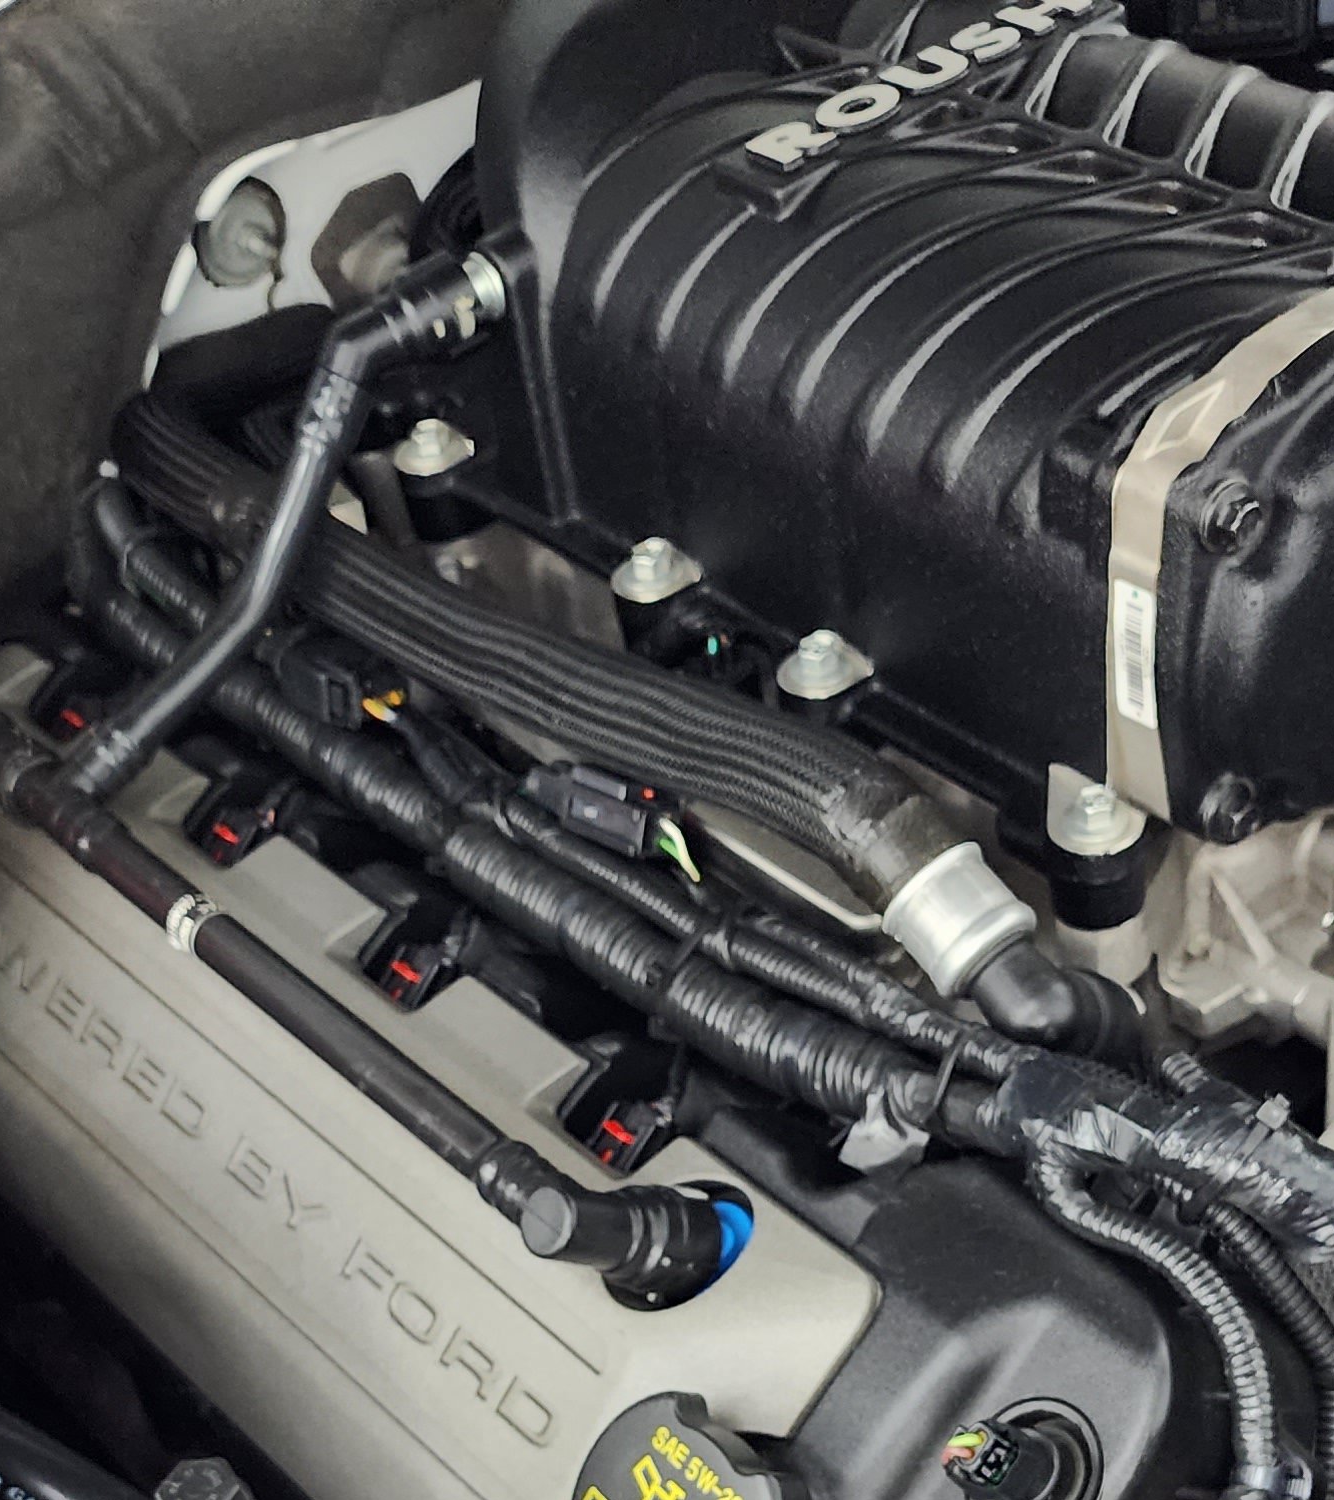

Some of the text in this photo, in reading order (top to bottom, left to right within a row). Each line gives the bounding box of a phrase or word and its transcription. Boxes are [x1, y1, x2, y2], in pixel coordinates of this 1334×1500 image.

[745, 0, 1093, 172] ROUSH
[227, 1134, 328, 1233] BY
[341, 1237, 557, 1450] FORD
[651, 1425, 688, 1470] SAE
